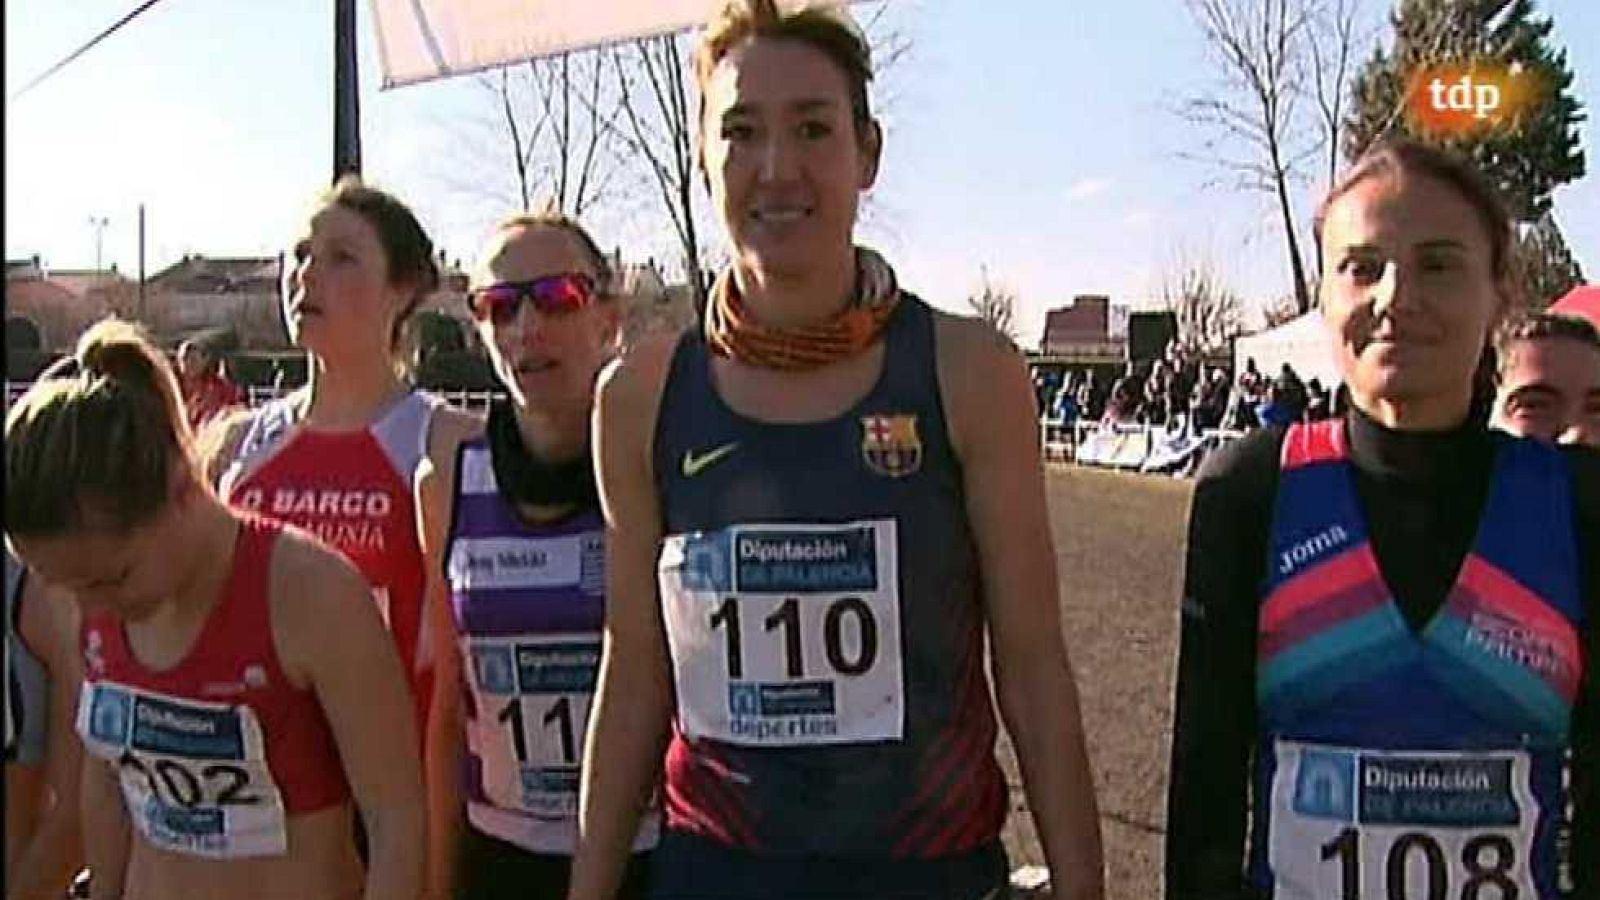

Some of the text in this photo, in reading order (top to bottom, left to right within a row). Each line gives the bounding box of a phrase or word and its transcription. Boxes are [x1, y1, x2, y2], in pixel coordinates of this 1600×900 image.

[271, 488, 392, 517] BARCO
[740, 537, 848, 563] Diputación
[709, 597, 878, 678] 110
[1364, 763, 1490, 793] Diputación
[1320, 826, 1520, 899] 108
